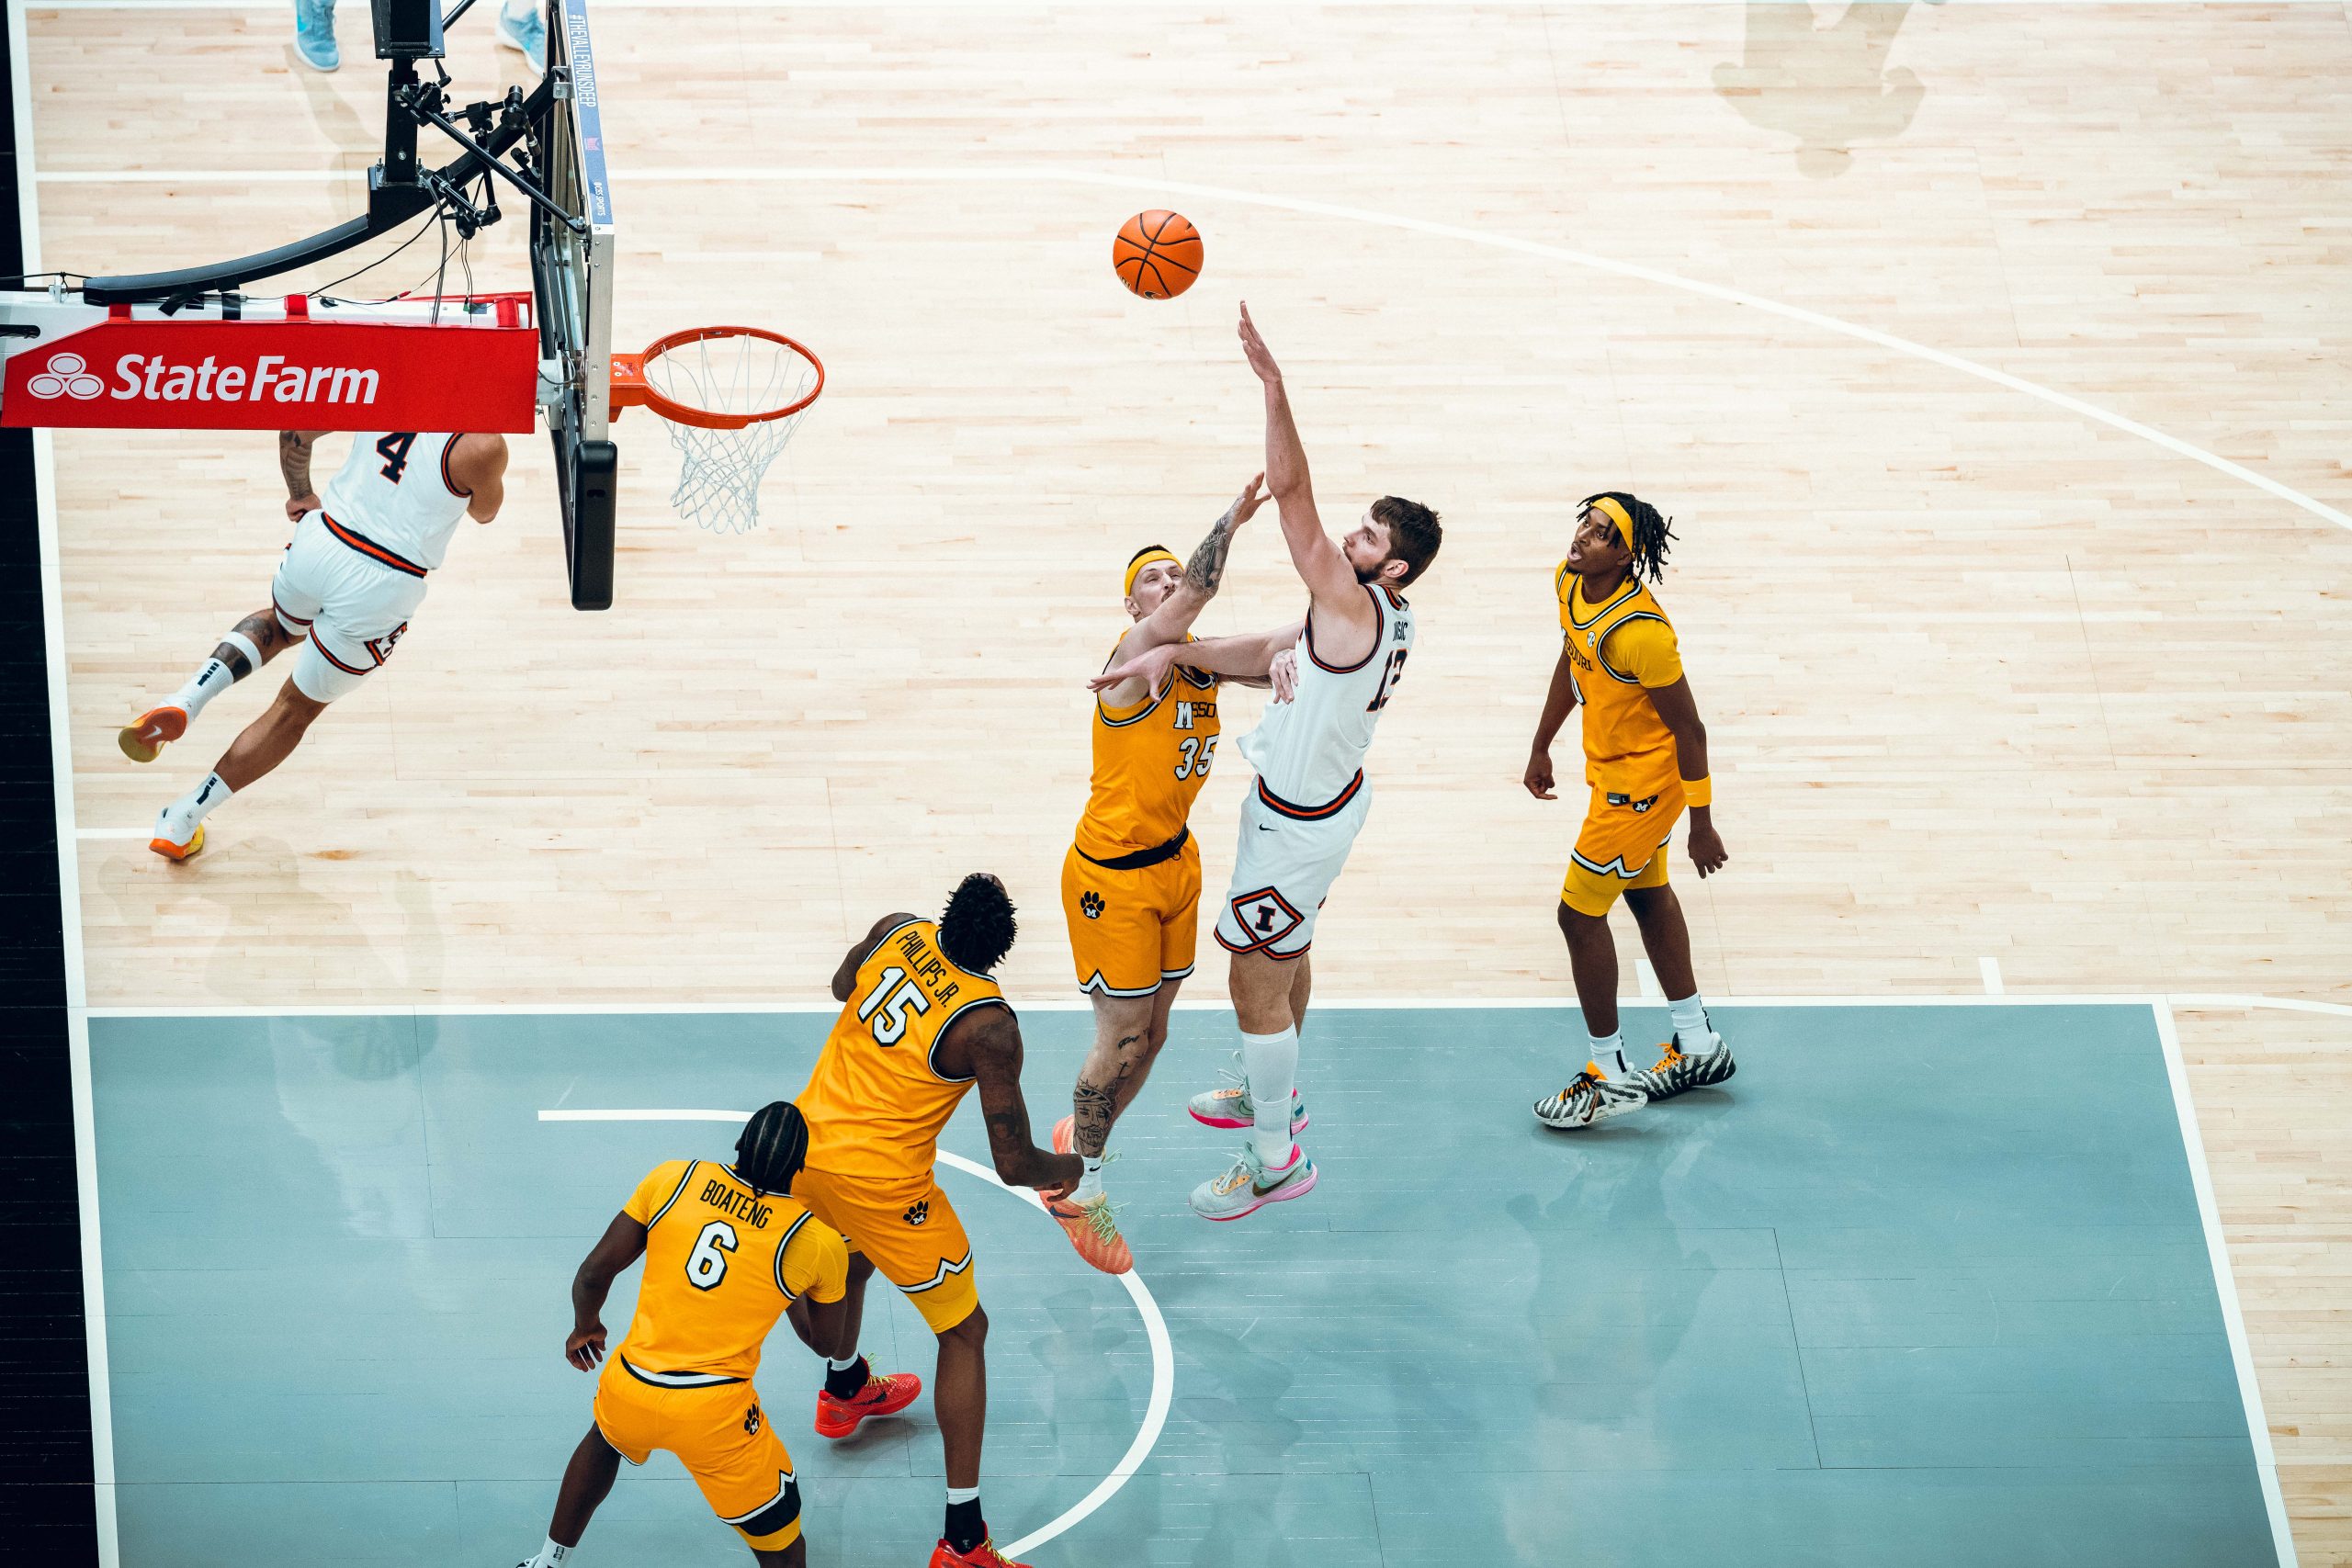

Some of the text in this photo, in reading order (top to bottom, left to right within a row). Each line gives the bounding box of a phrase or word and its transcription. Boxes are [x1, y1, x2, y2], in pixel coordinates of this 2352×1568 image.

[569, 14, 596, 107] #THEVALLEYRUNSDEEP
[595, 195, 606, 217] SPORTS
[377, 432, 418, 485] 4
[1173, 733, 1220, 782] 35
[1634, 802, 1649, 812] M
[1085, 908, 1097, 919] M
[1254, 903, 1277, 933] I
[896, 930, 960, 1009] PHILLIPS JR.
[857, 966, 932, 1048] 15
[699, 1179, 774, 1230] BOATENG
[684, 1219, 740, 1292] 6
